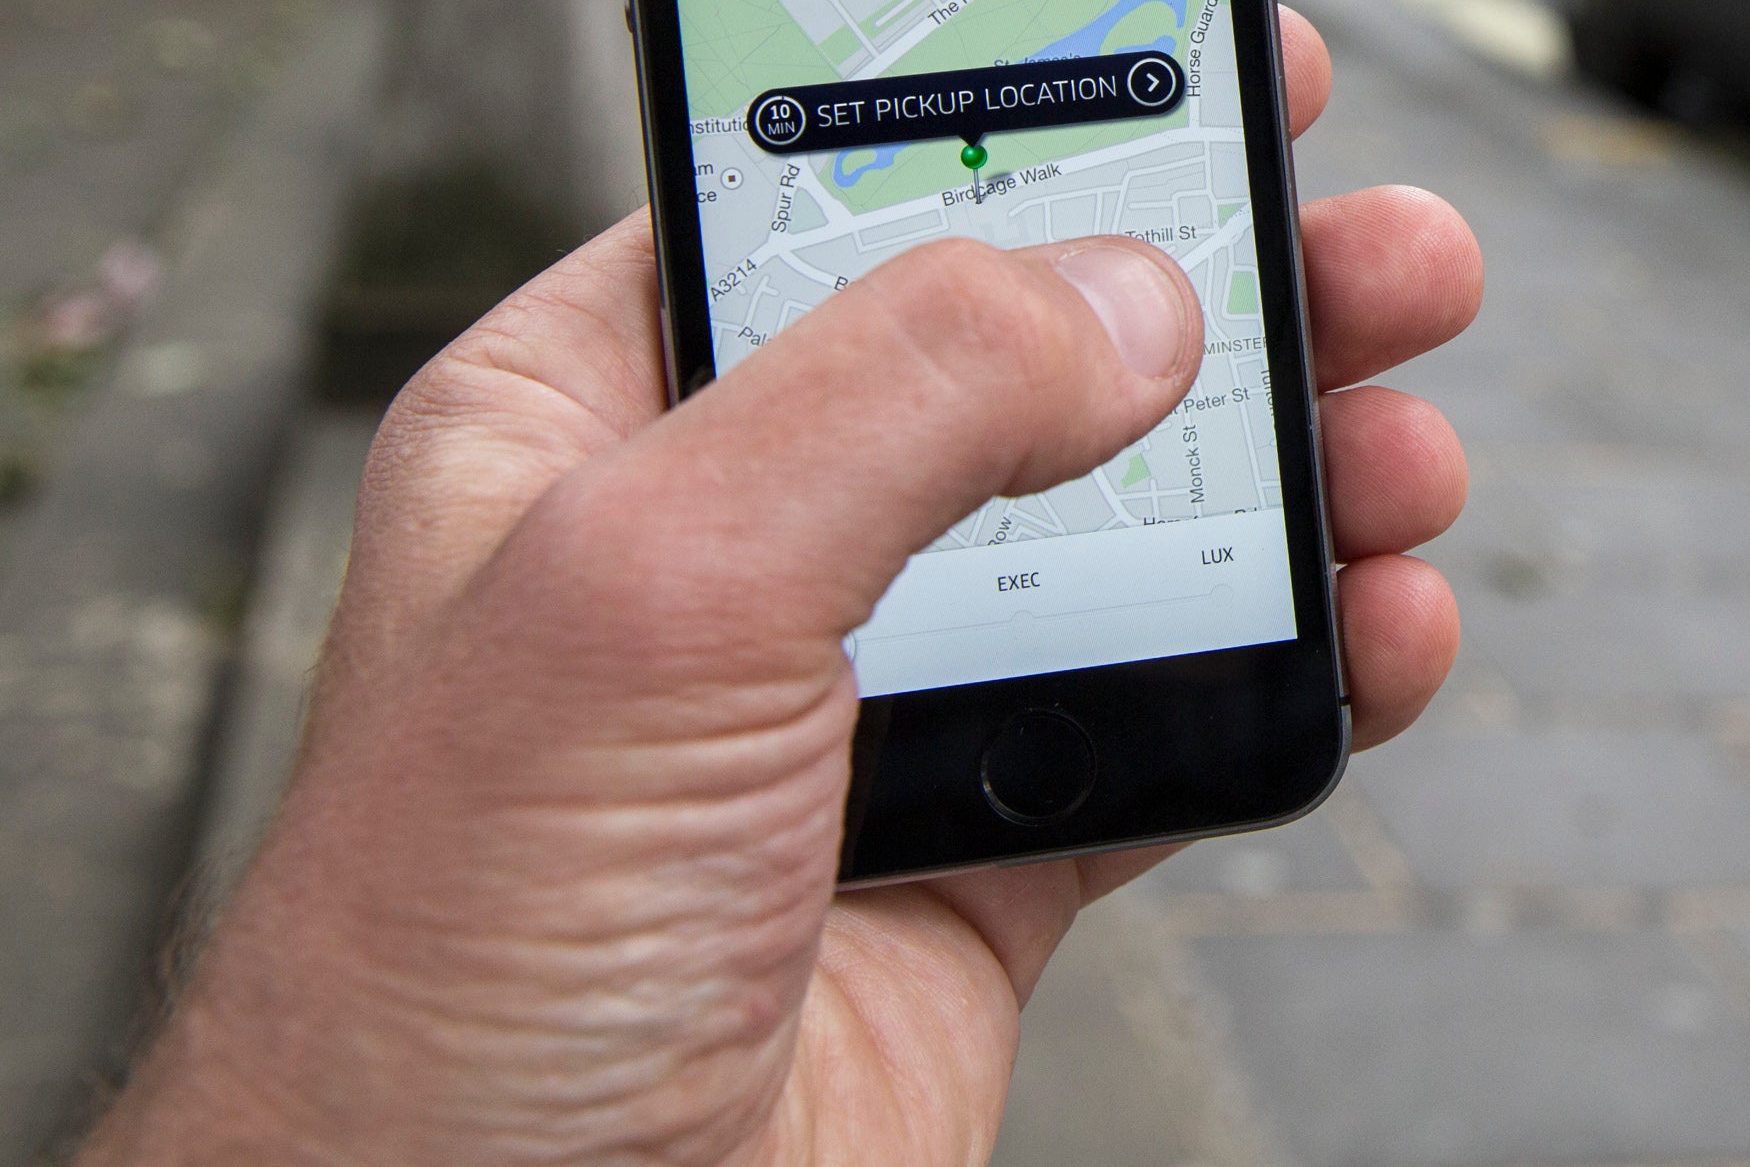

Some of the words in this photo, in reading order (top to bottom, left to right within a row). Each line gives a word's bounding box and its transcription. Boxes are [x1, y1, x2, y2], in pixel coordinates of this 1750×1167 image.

[927, 0, 962, 28] The
[1186, 49, 1202, 97] Horse
[769, 102, 791, 120] 10
[817, 100, 865, 128] SET
[875, 90, 975, 122] PICKUP
[984, 75, 1118, 111] LOCATION
[767, 119, 796, 136] MIN
[780, 163, 801, 188] Rd
[941, 176, 1018, 208] Birdcage
[1018, 162, 1063, 187] Walk
[770, 195, 793, 233] Spur
[1178, 225, 1197, 240] St
[709, 258, 758, 302] A3214
[1183, 394, 1227, 414] Peter
[1231, 387, 1251, 403] St
[1182, 424, 1197, 443] St
[1186, 446, 1204, 504] Monck
[1201, 546, 1235, 566] LUX
[997, 571, 1041, 592] EXEC
